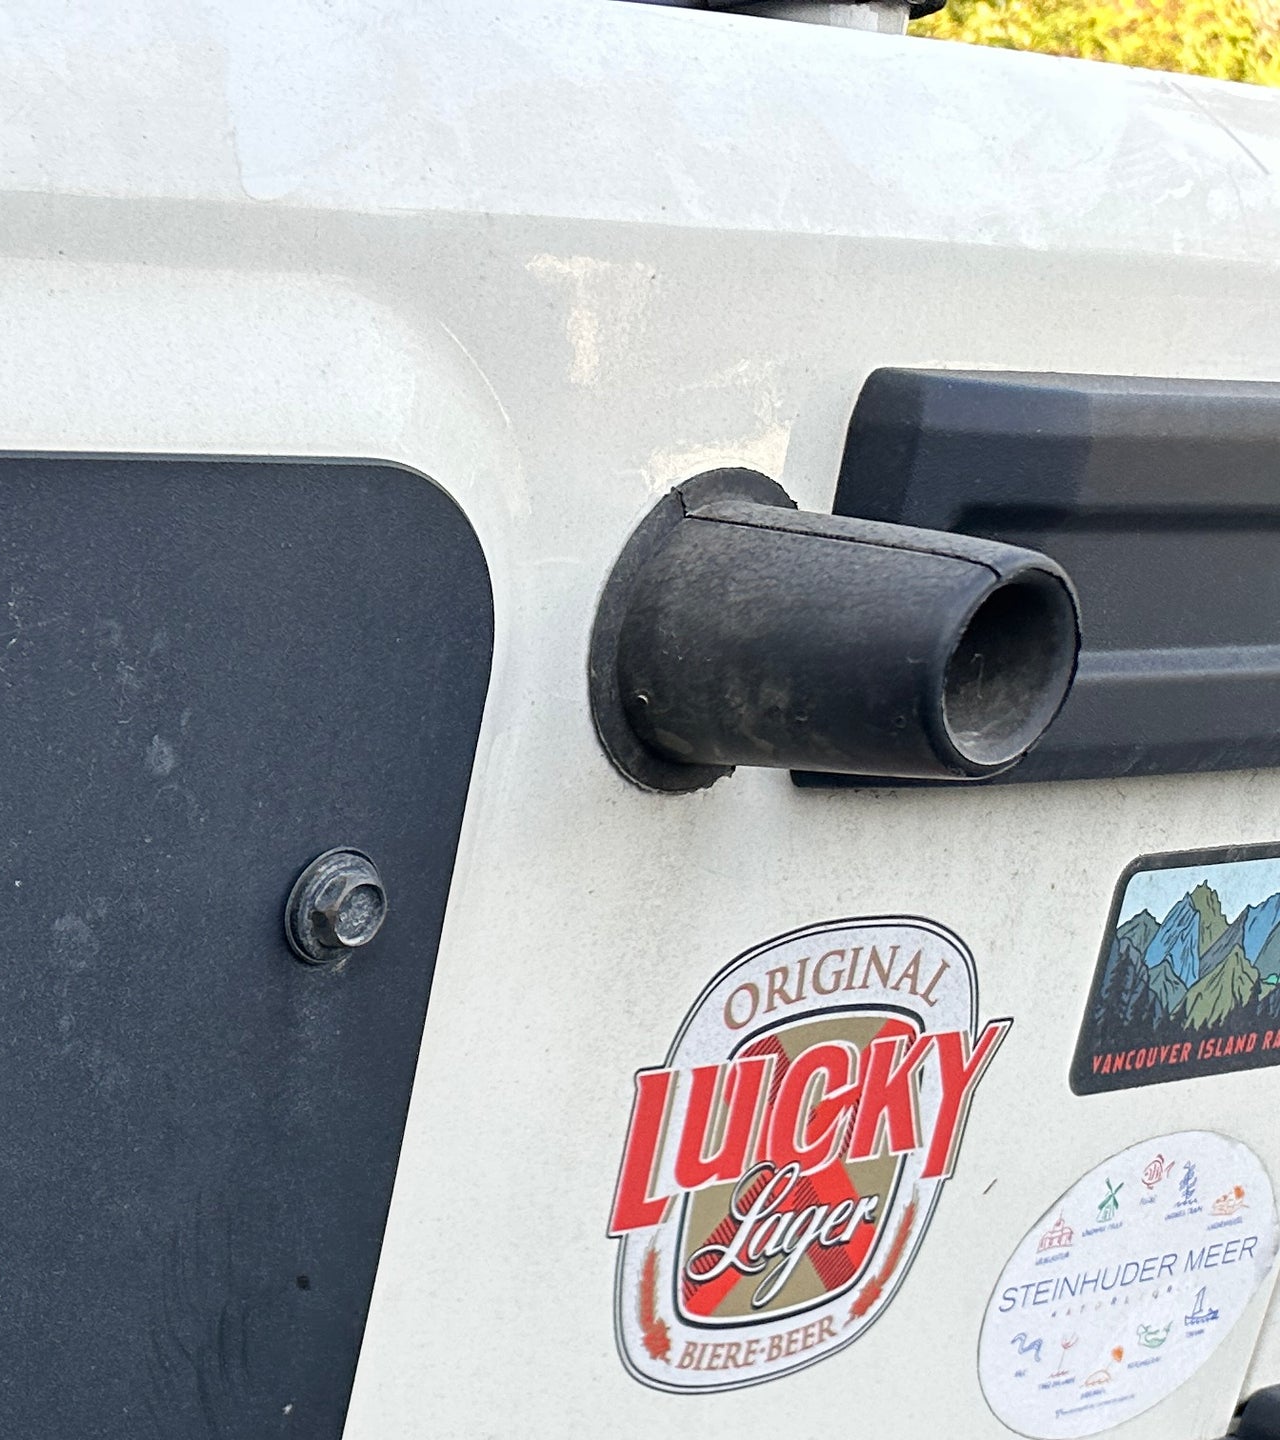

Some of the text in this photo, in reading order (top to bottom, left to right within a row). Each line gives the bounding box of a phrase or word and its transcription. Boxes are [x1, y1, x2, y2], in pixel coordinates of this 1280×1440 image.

[723, 944, 952, 1031] ORIGINAL
[1092, 1042, 1193, 1075] VANCOUVER
[1197, 1032, 1258, 1060] ISLAND
[610, 1018, 1013, 1236] LUCKY
[685, 1161, 880, 1308] Lager
[998, 1252, 1179, 1313] STEINHUDER
[1183, 1235, 1260, 1273] MEER
